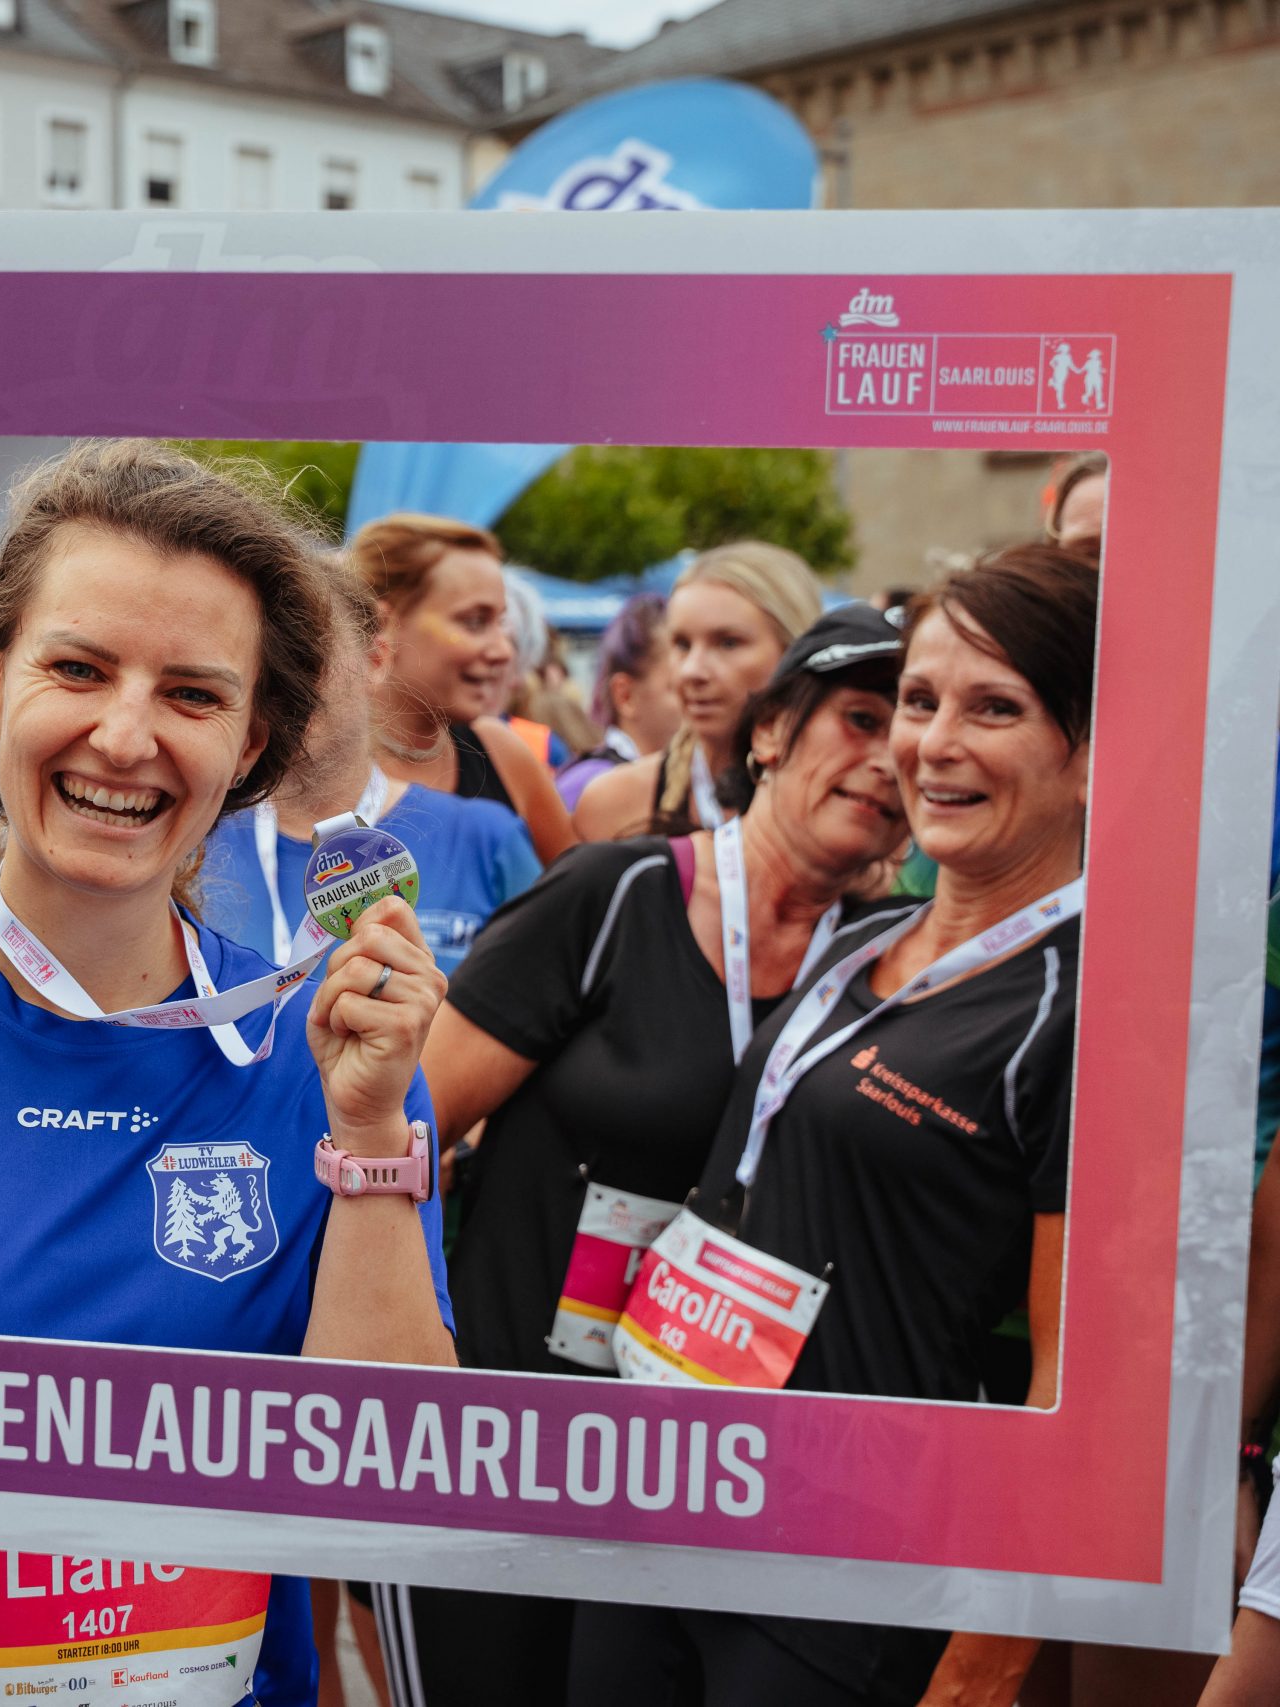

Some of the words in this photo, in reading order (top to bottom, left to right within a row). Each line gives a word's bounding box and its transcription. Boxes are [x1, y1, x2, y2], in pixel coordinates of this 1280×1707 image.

[849, 287, 895, 314] dm
[838, 342, 925, 368] FRAUEN
[939, 367, 1036, 386] SAARLOUIS
[836, 373, 924, 405] LAUF
[932, 420, 1109, 434] WWW.FRAUENLAUF-SAARLOUIS.DE
[318, 852, 344, 872] dm
[311, 869, 382, 911] FRAUENLAUF
[382, 857, 412, 879] 2026
[4, 930, 23, 950] LAUF
[9, 925, 27, 944] FRAUEN
[276, 970, 301, 986] dm
[856, 1077, 922, 1126] Saarlouis
[870, 1062, 978, 1135] Kreissparkasse
[17, 1107, 127, 1131] CRAFT
[198, 1146, 214, 1156] TV
[178, 1156, 238, 1170] LUDWEILER
[647, 1260, 754, 1352] Carolin
[658, 1321, 687, 1352] 143
[61, 1603, 134, 1640] 1407
[57, 1645, 99, 1660] STARTZEIT
[100, 1642, 122, 1655] 18:00
[123, 1639, 140, 1651] UHR
[129, 1670, 169, 1683] Kaufland
[179, 1664, 210, 1675] COSMOS
[16, 1680, 58, 1696] Bitburger
[69, 1677, 87, 1691] 0.0
